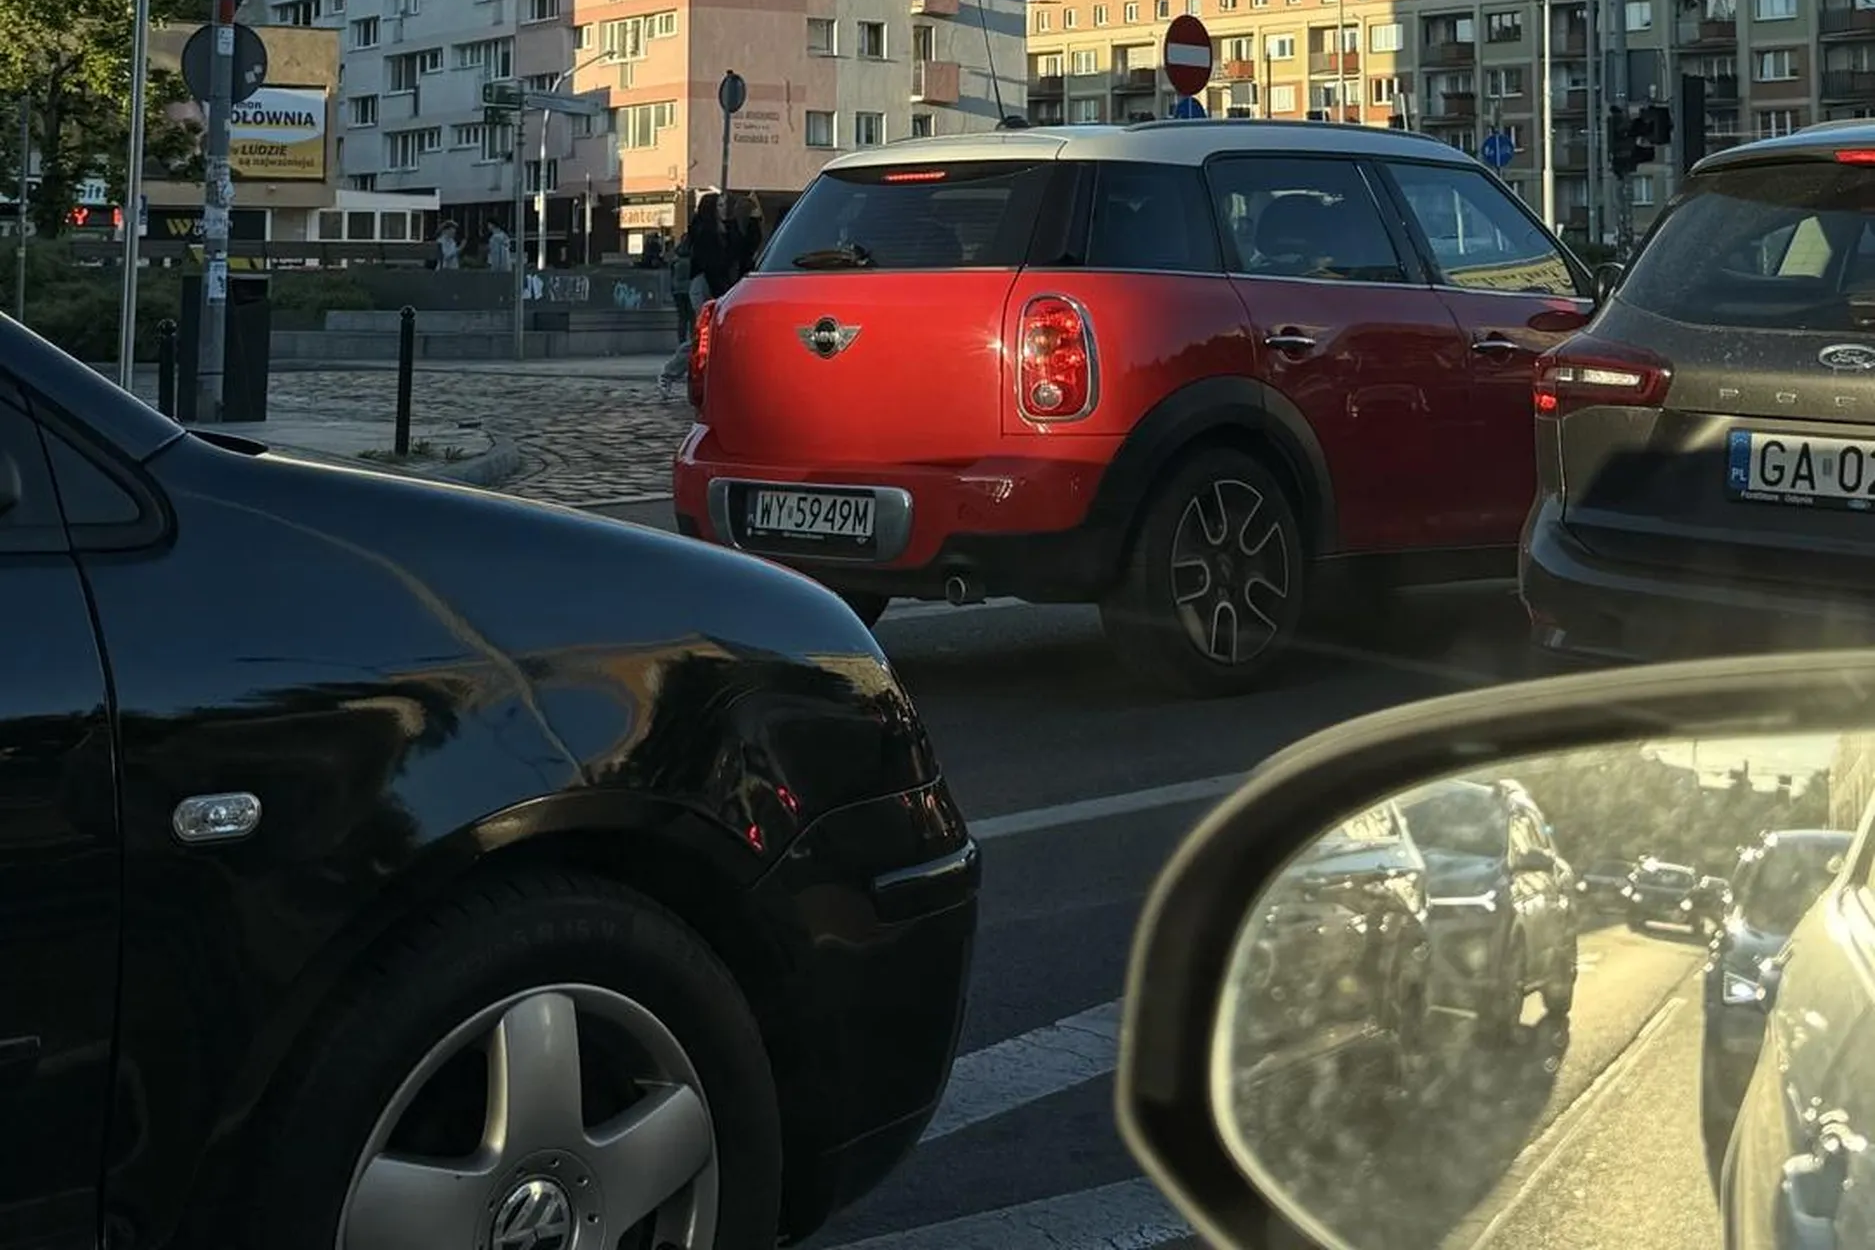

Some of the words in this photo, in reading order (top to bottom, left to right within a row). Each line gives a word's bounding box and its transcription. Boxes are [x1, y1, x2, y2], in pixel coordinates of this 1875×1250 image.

[231, 110, 315, 126] OŁOWNIA
[241, 144, 288, 156] LUDZIE
[1760, 440, 1816, 491] GA
[1731, 467, 1747, 482] PL
[760, 495, 786, 527] WY
[795, 498, 869, 534] 5949M
